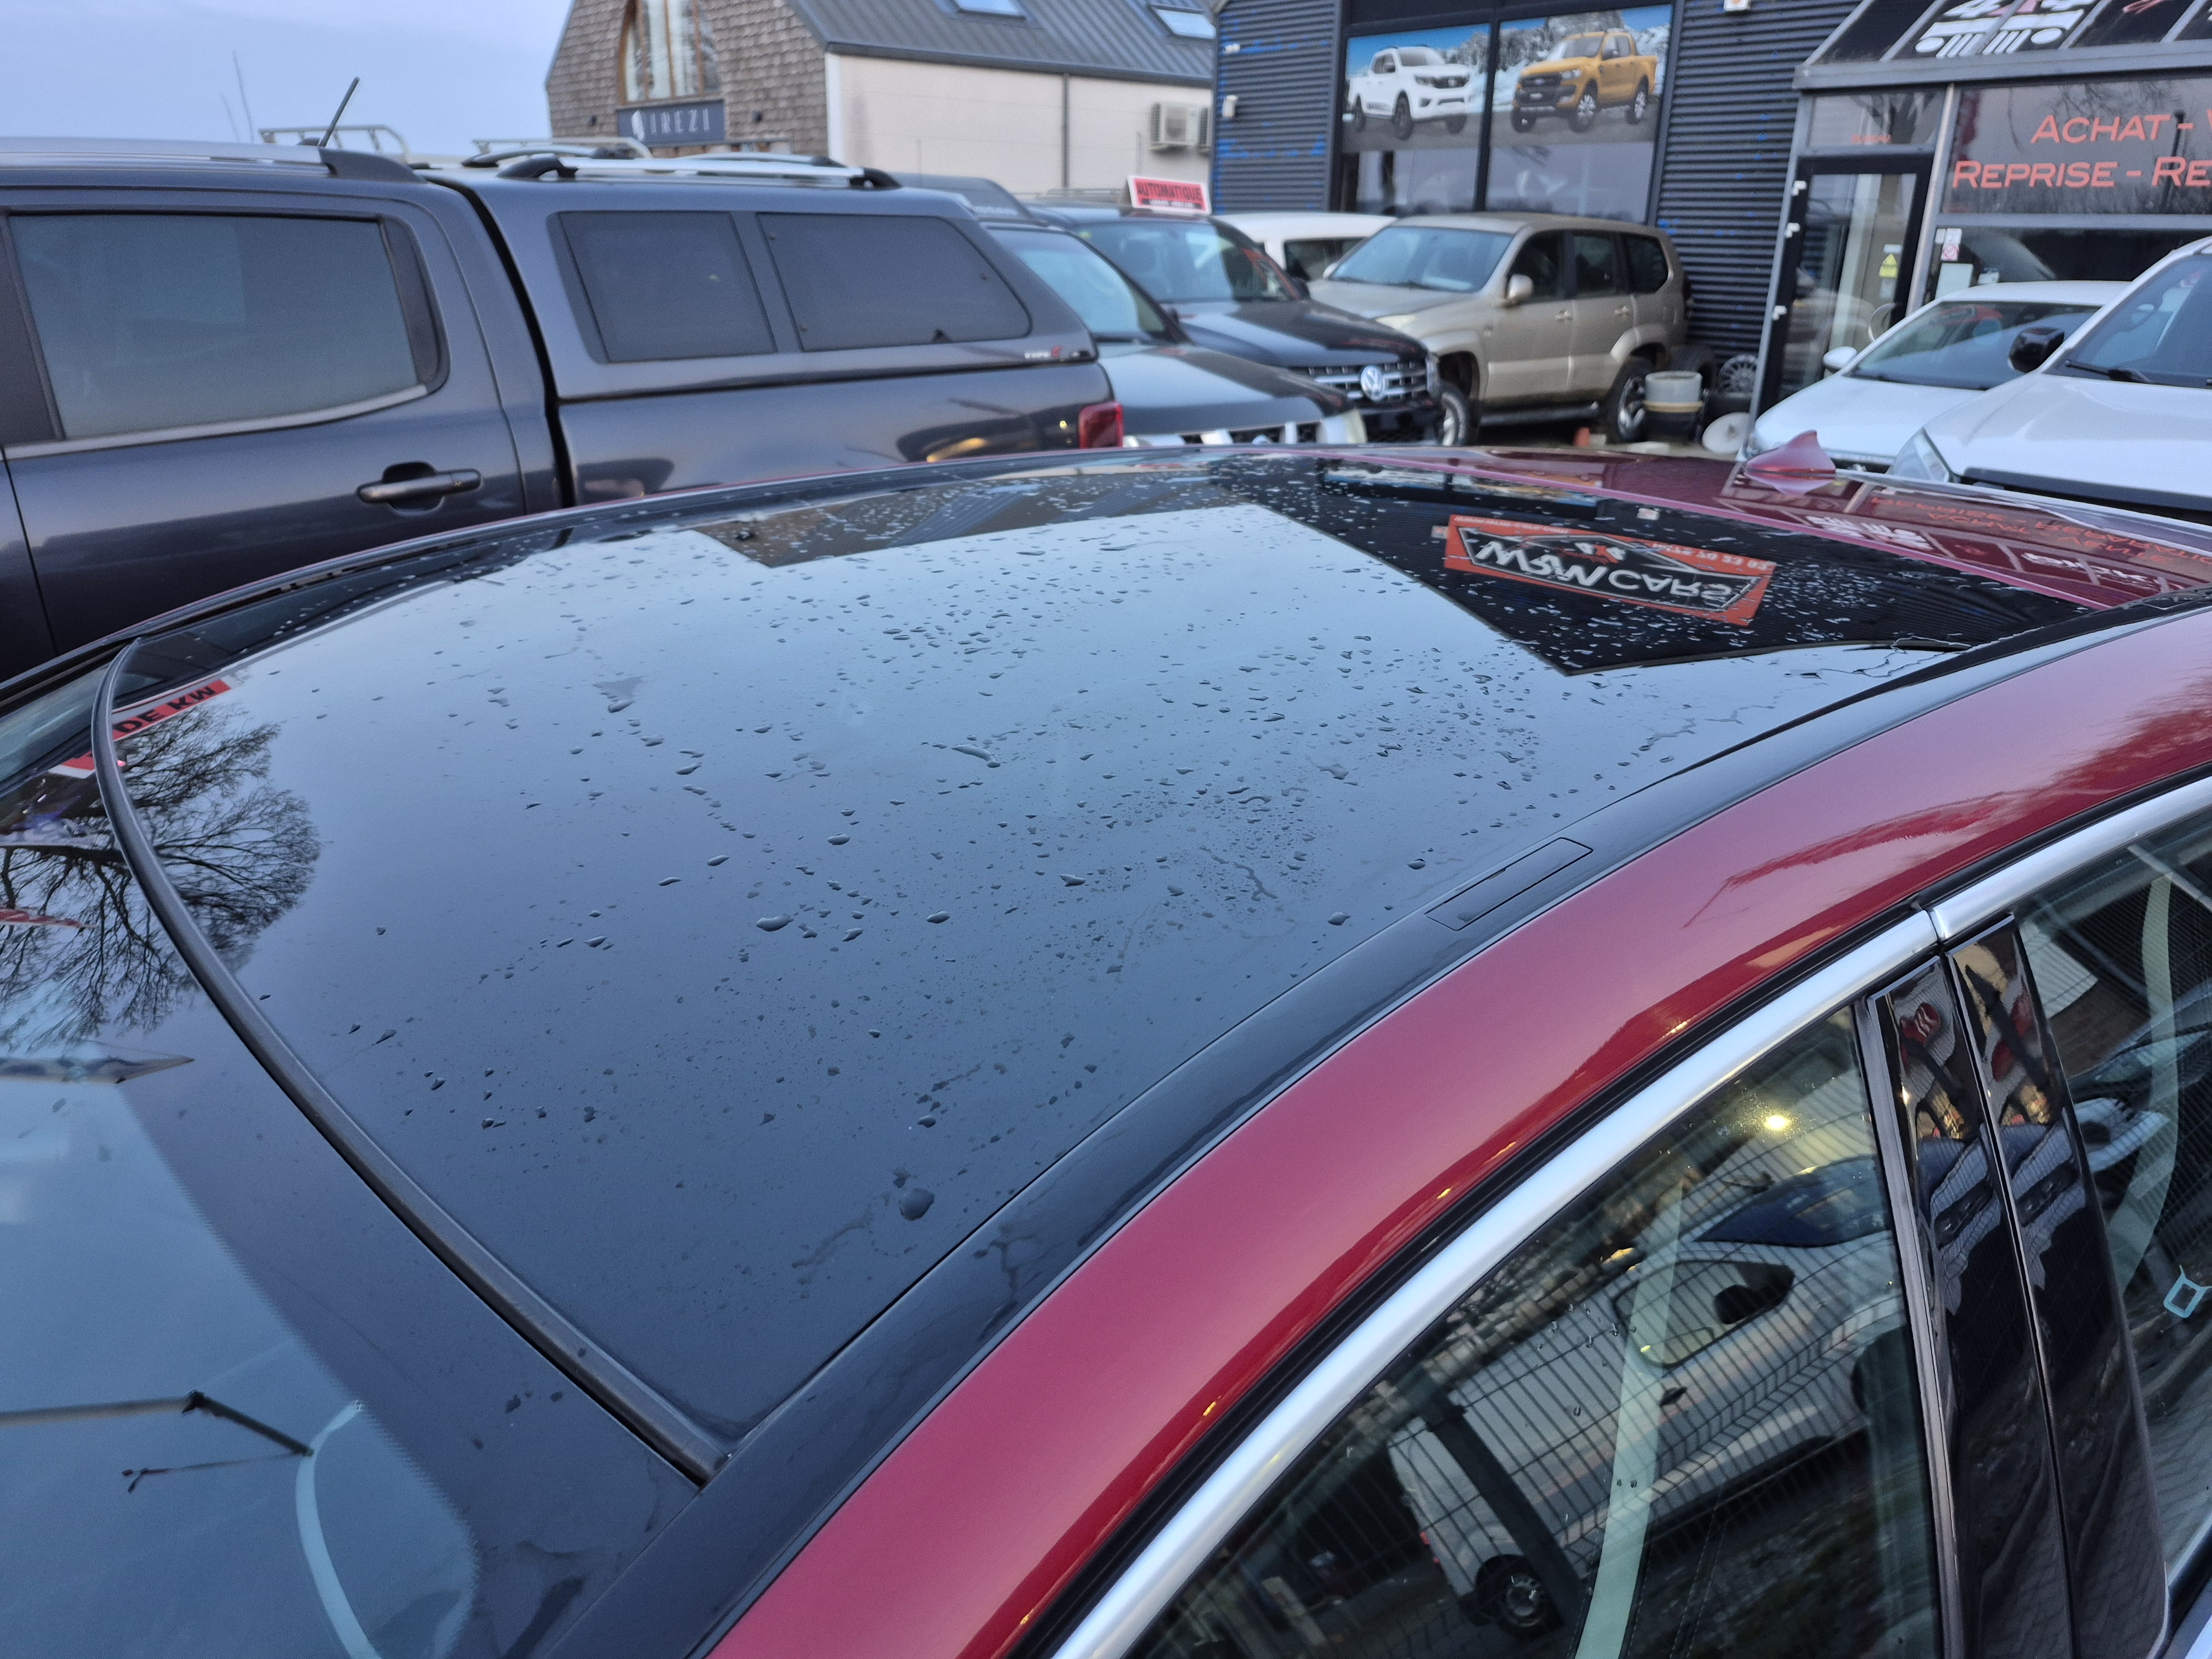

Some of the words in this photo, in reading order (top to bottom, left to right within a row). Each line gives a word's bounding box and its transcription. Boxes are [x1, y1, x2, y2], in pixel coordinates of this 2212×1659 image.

[2030, 114, 2172, 144] ACHAT
[1953, 160, 2119, 189] REPRISE
[2152, 156, 2212, 187] RE
[1135, 181, 1203, 202] AUTOMATIQUE
